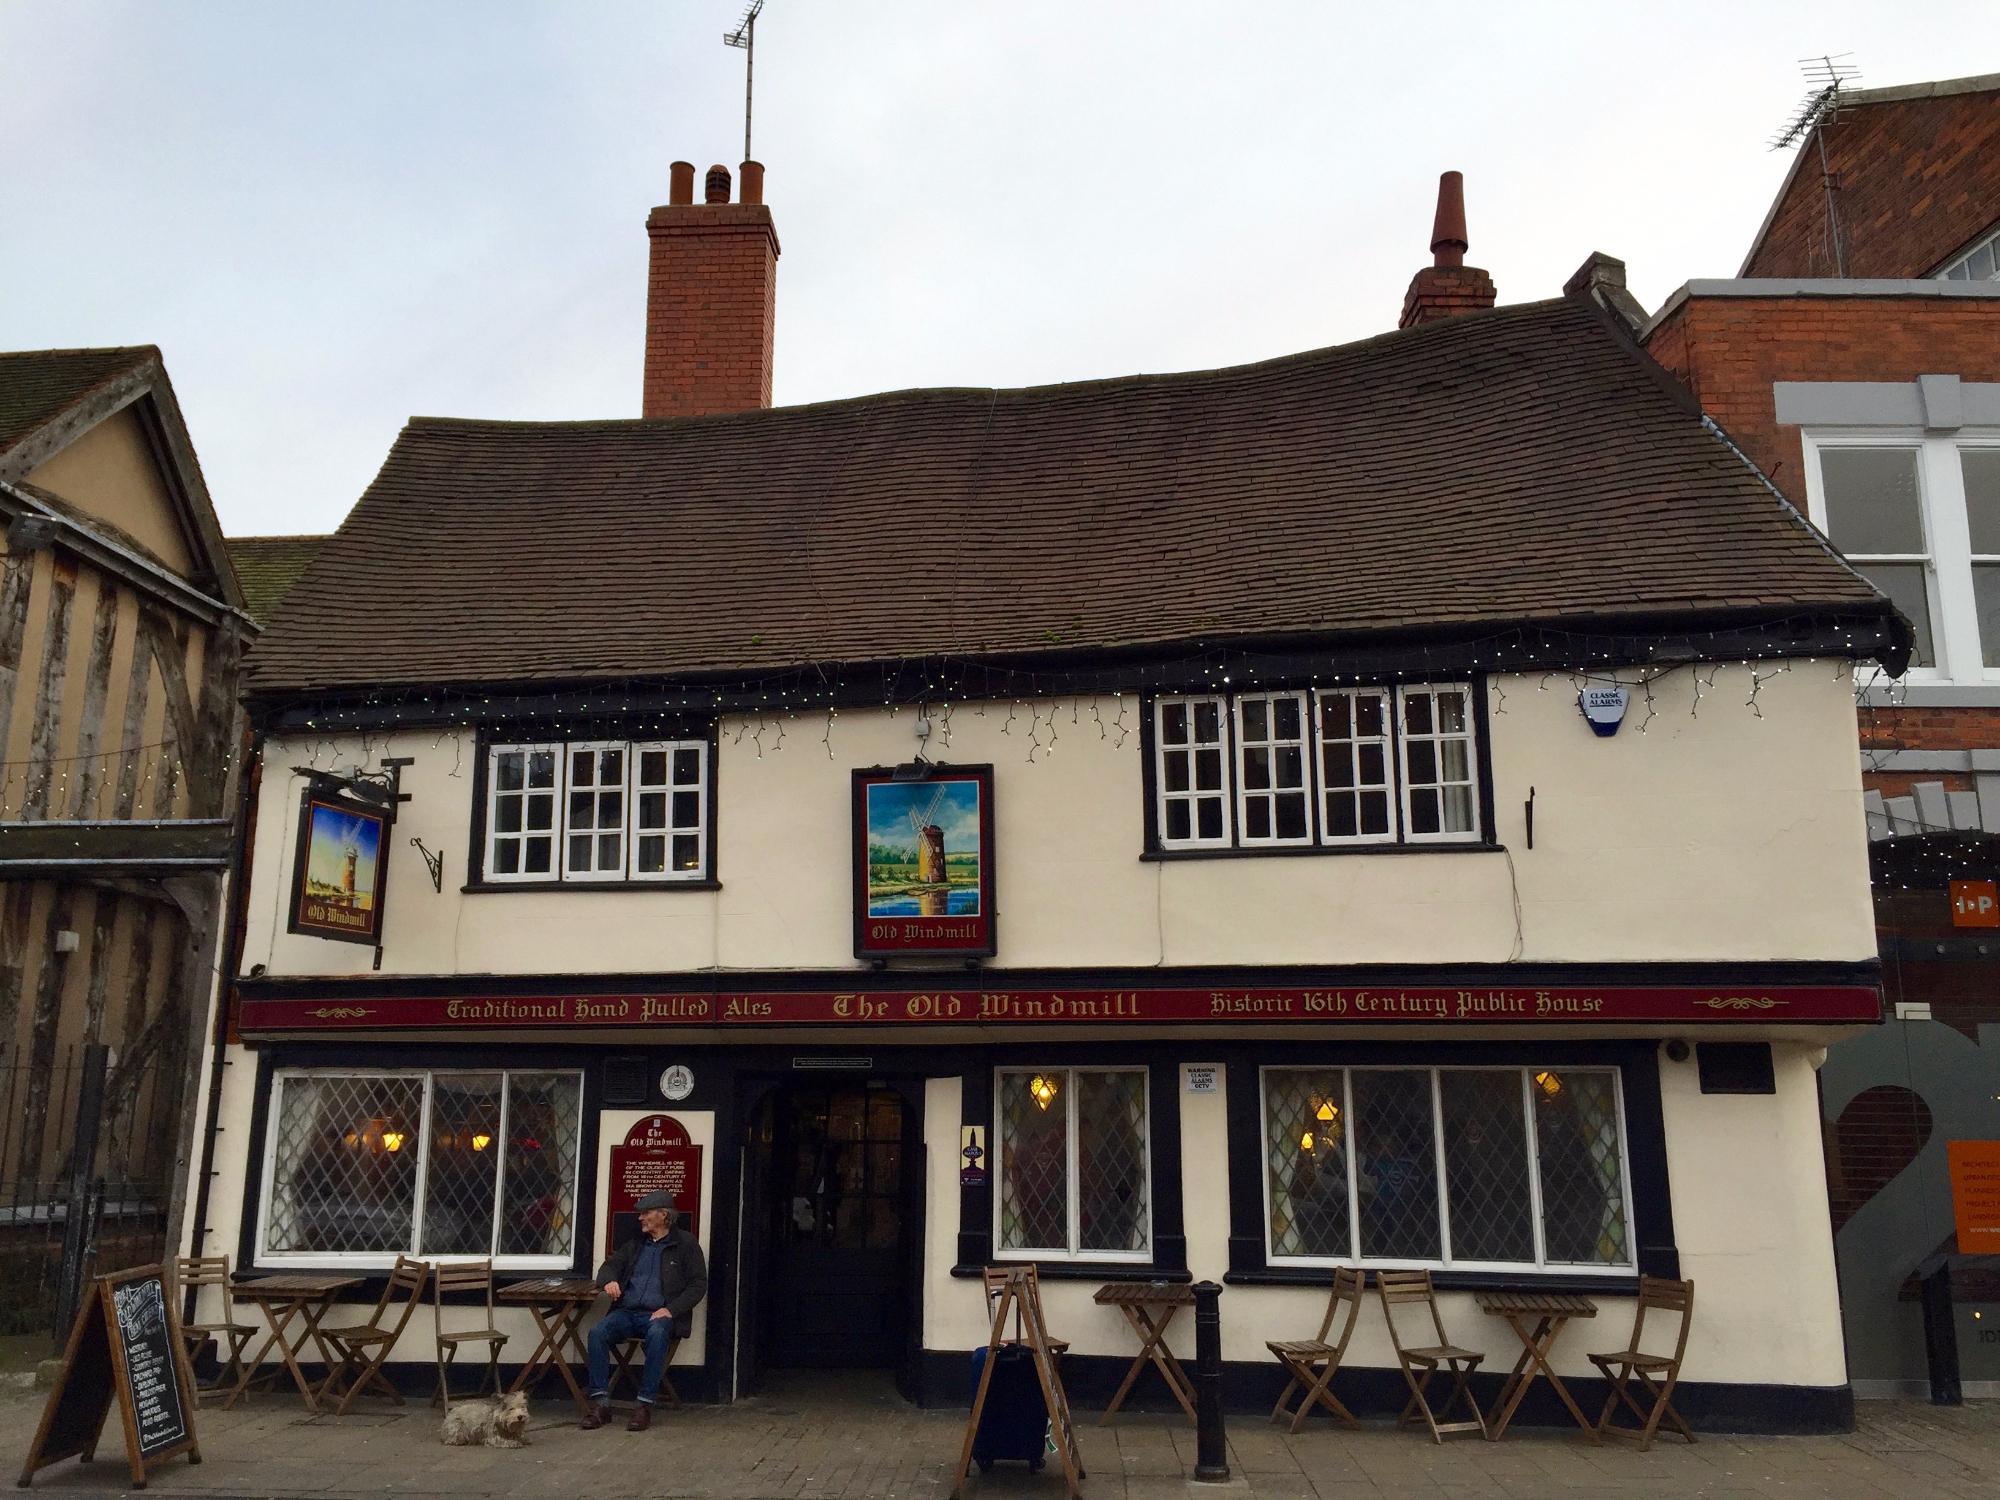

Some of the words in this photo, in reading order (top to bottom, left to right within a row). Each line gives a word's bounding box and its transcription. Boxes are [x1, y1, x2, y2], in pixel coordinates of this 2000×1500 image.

[308, 904, 326, 921] Old
[327, 906, 366, 927] Windmill
[871, 925, 898, 939] Old
[903, 924, 977, 943] Windmill
[447, 999, 566, 1019] Traditional
[574, 996, 629, 1021] Hand
[640, 996, 708, 1022] Pulled
[724, 996, 772, 1021] Ales
[832, 994, 889, 1020] The
[906, 994, 961, 1017] Old
[977, 993, 1141, 1021] Windmill
[1210, 992, 1293, 1017] Historic
[1302, 991, 1347, 1015] 16th
[1355, 992, 1448, 1018] Century
[1456, 991, 1527, 1018] Public
[1535, 991, 1604, 1017] House
[630, 1138, 643, 1147] Old
[645, 1137, 682, 1148] Windmill
[647, 1128, 663, 1137] The
